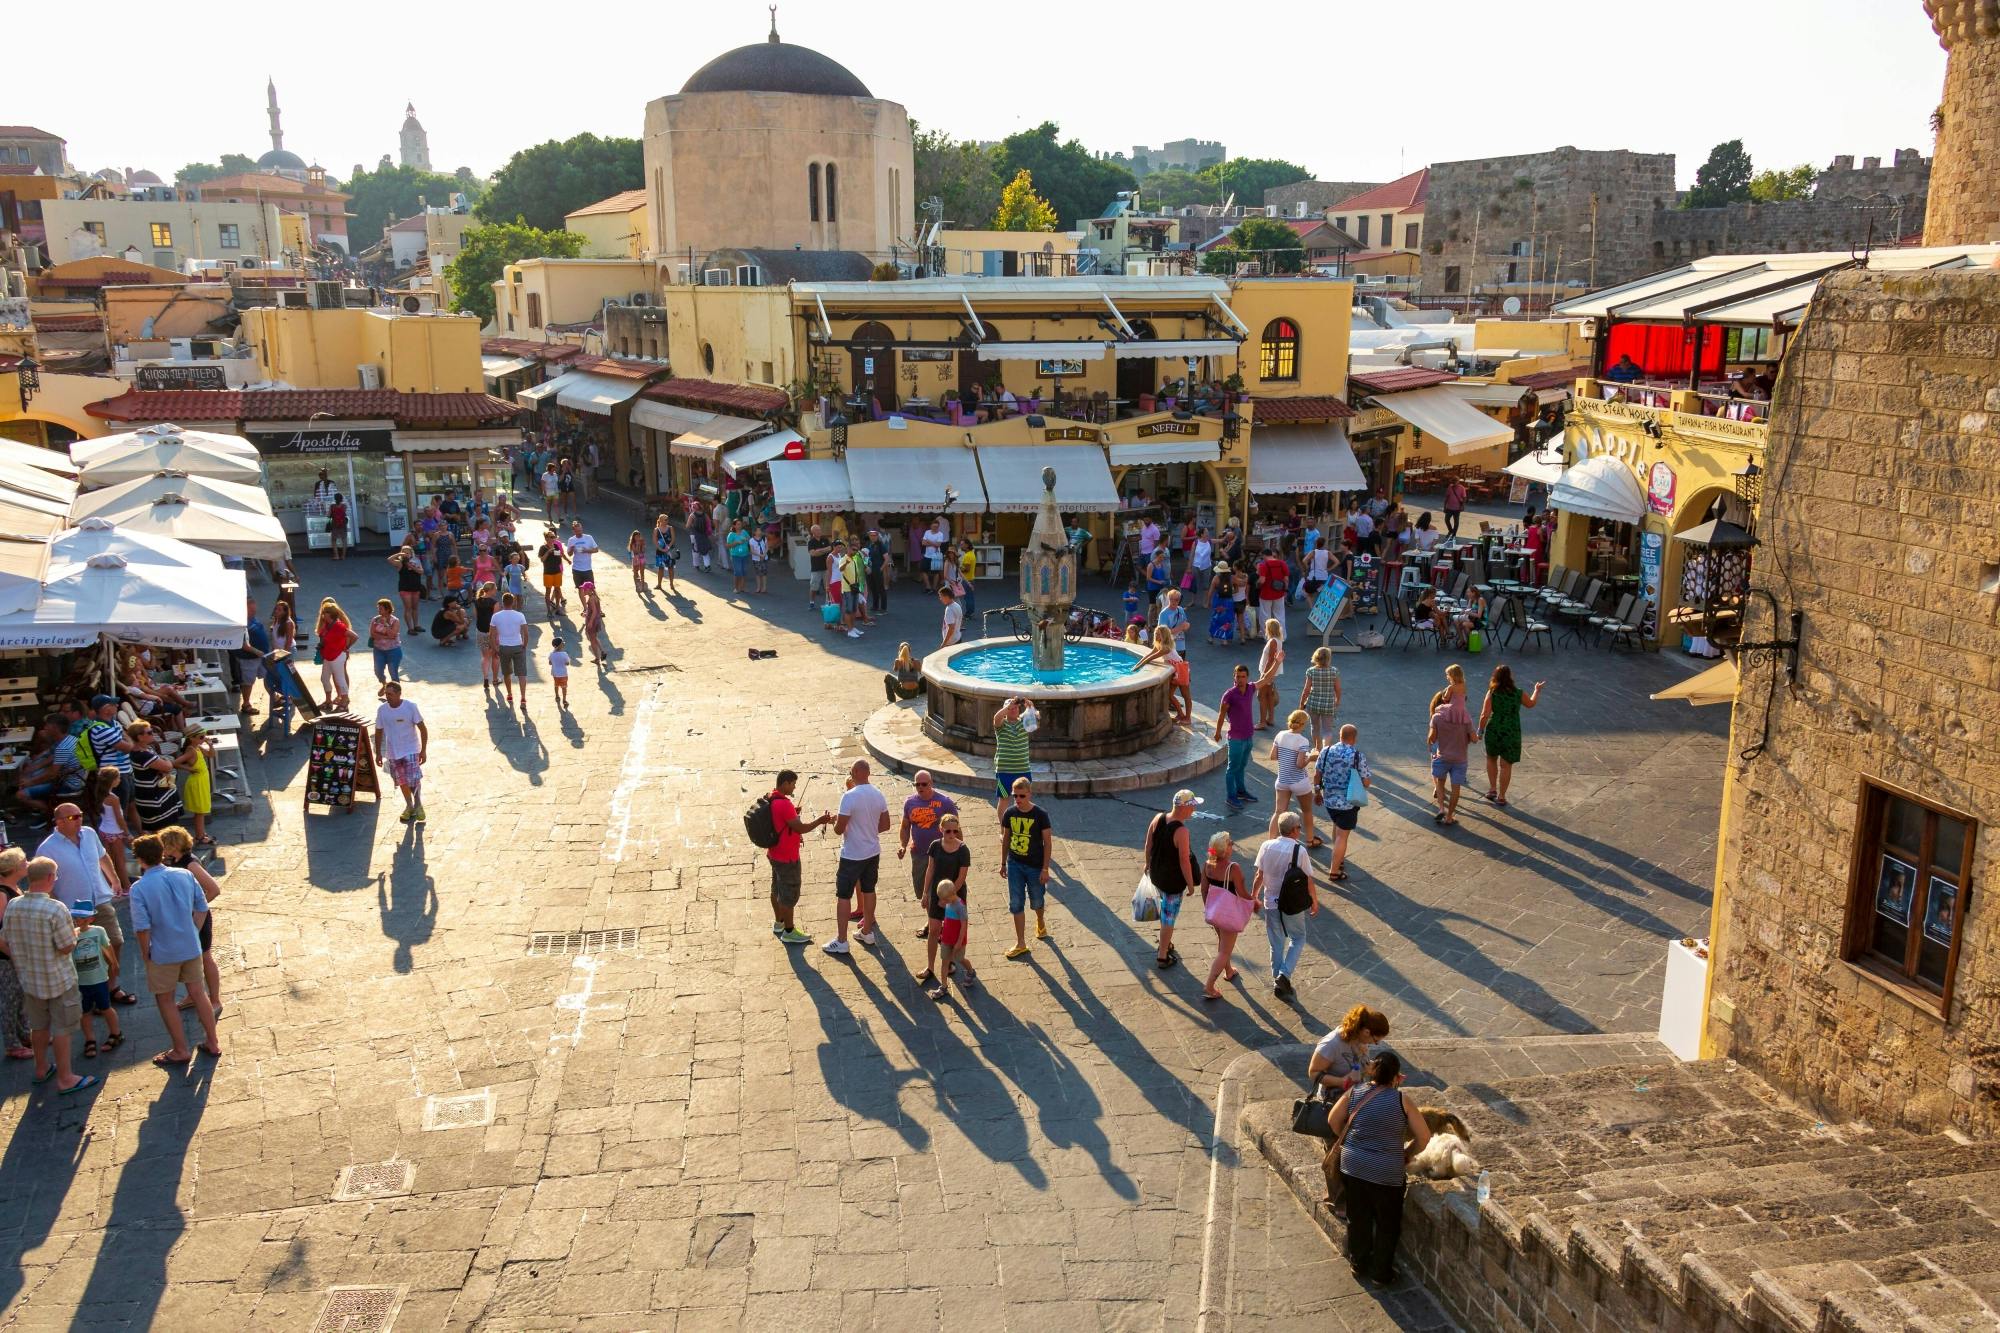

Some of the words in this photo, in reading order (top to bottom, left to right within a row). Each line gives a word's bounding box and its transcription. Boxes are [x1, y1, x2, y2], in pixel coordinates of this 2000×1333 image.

[144, 369, 170, 380] KIOSK
[1603, 404, 1627, 417] STEAK
[1628, 408, 1656, 421] HOUSE
[1152, 424, 1186, 434] NEFELI
[1719, 423, 1755, 437] RESTAURANT
[279, 430, 361, 451] Apostolia
[1058, 504, 1097, 512] nterfurs
[150, 636, 233, 647] Archipelagos
